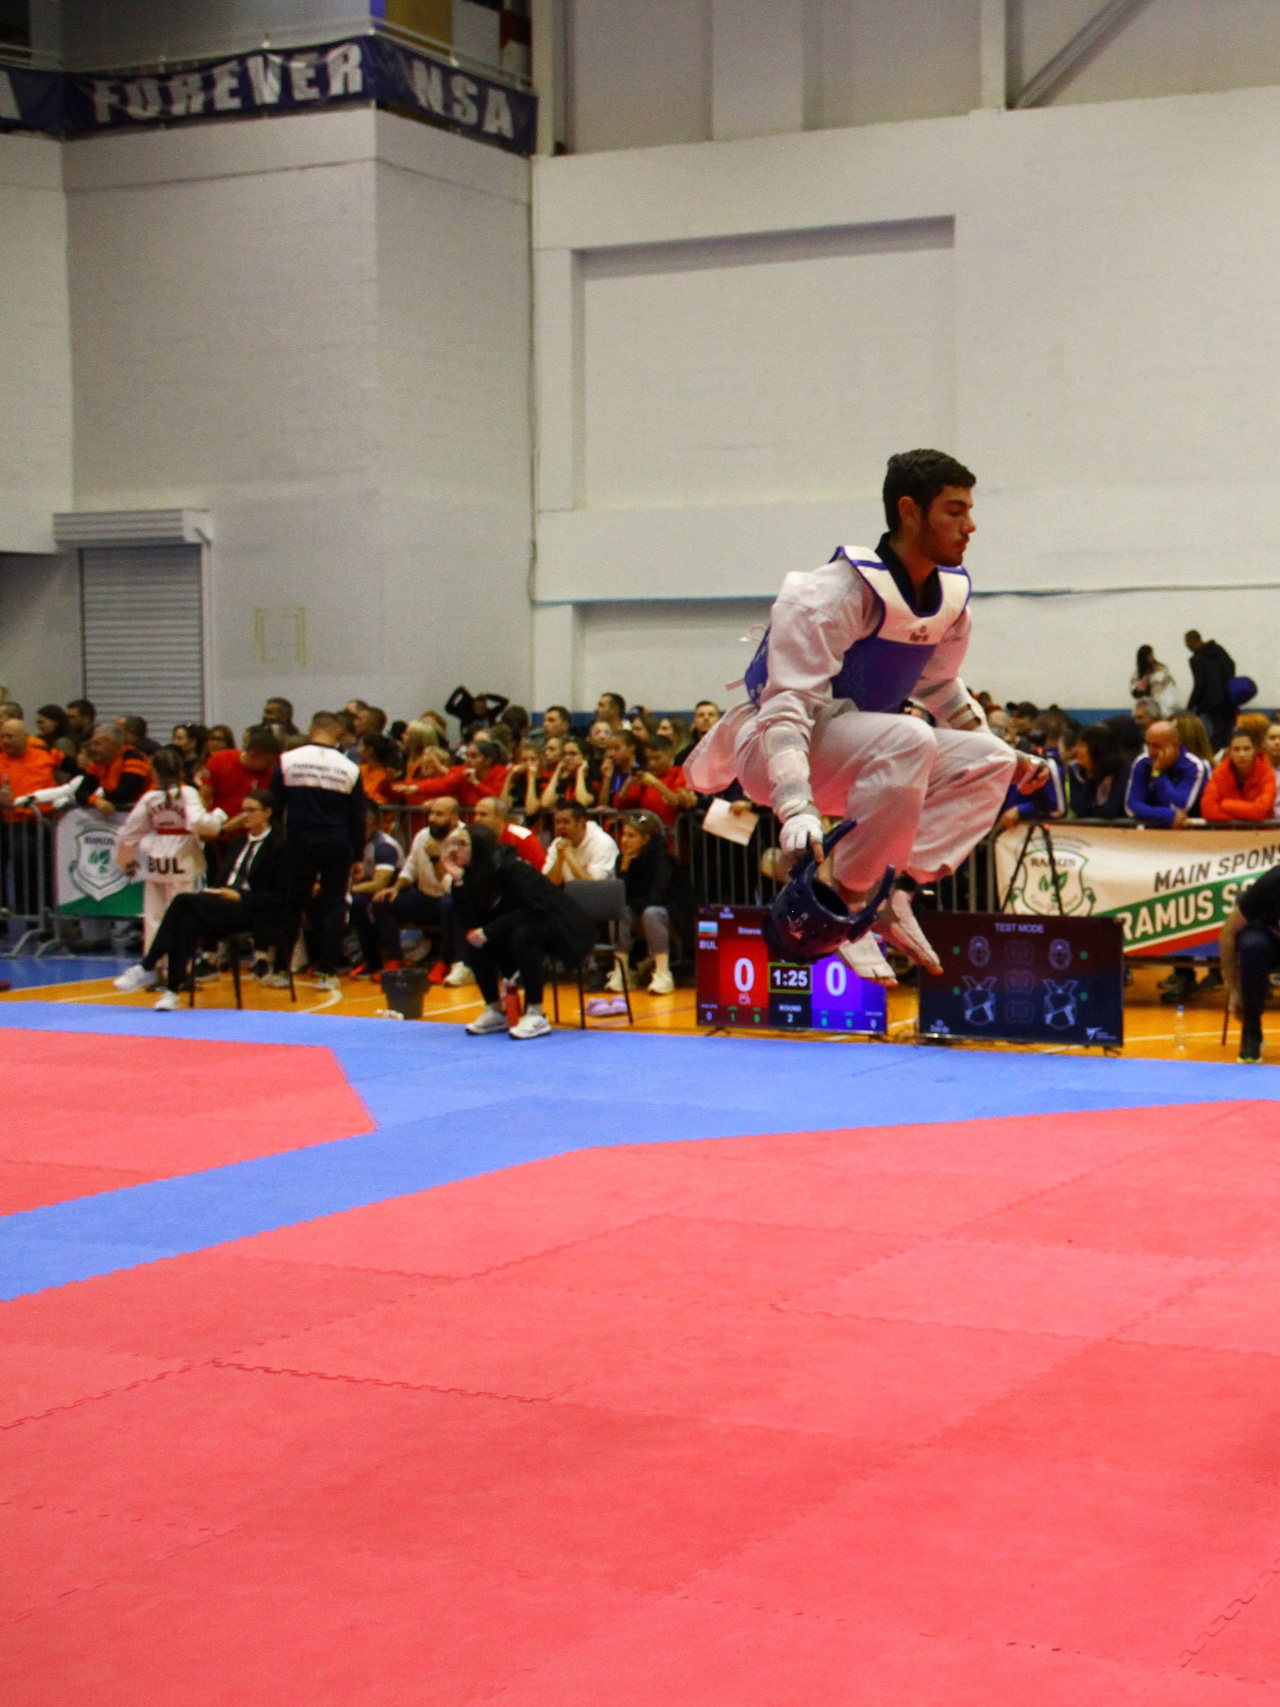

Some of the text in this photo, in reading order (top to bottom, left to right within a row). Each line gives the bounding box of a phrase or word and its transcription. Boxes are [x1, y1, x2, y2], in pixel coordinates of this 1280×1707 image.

[148, 857, 187, 875] BUL
[1154, 861, 1212, 893] MAIN
[995, 923, 1045, 934] TEST MODE
[1116, 890, 1215, 942] RAMUS
[698, 940, 718, 950] BUL
[734, 958, 847, 997] 0 1:25 0
